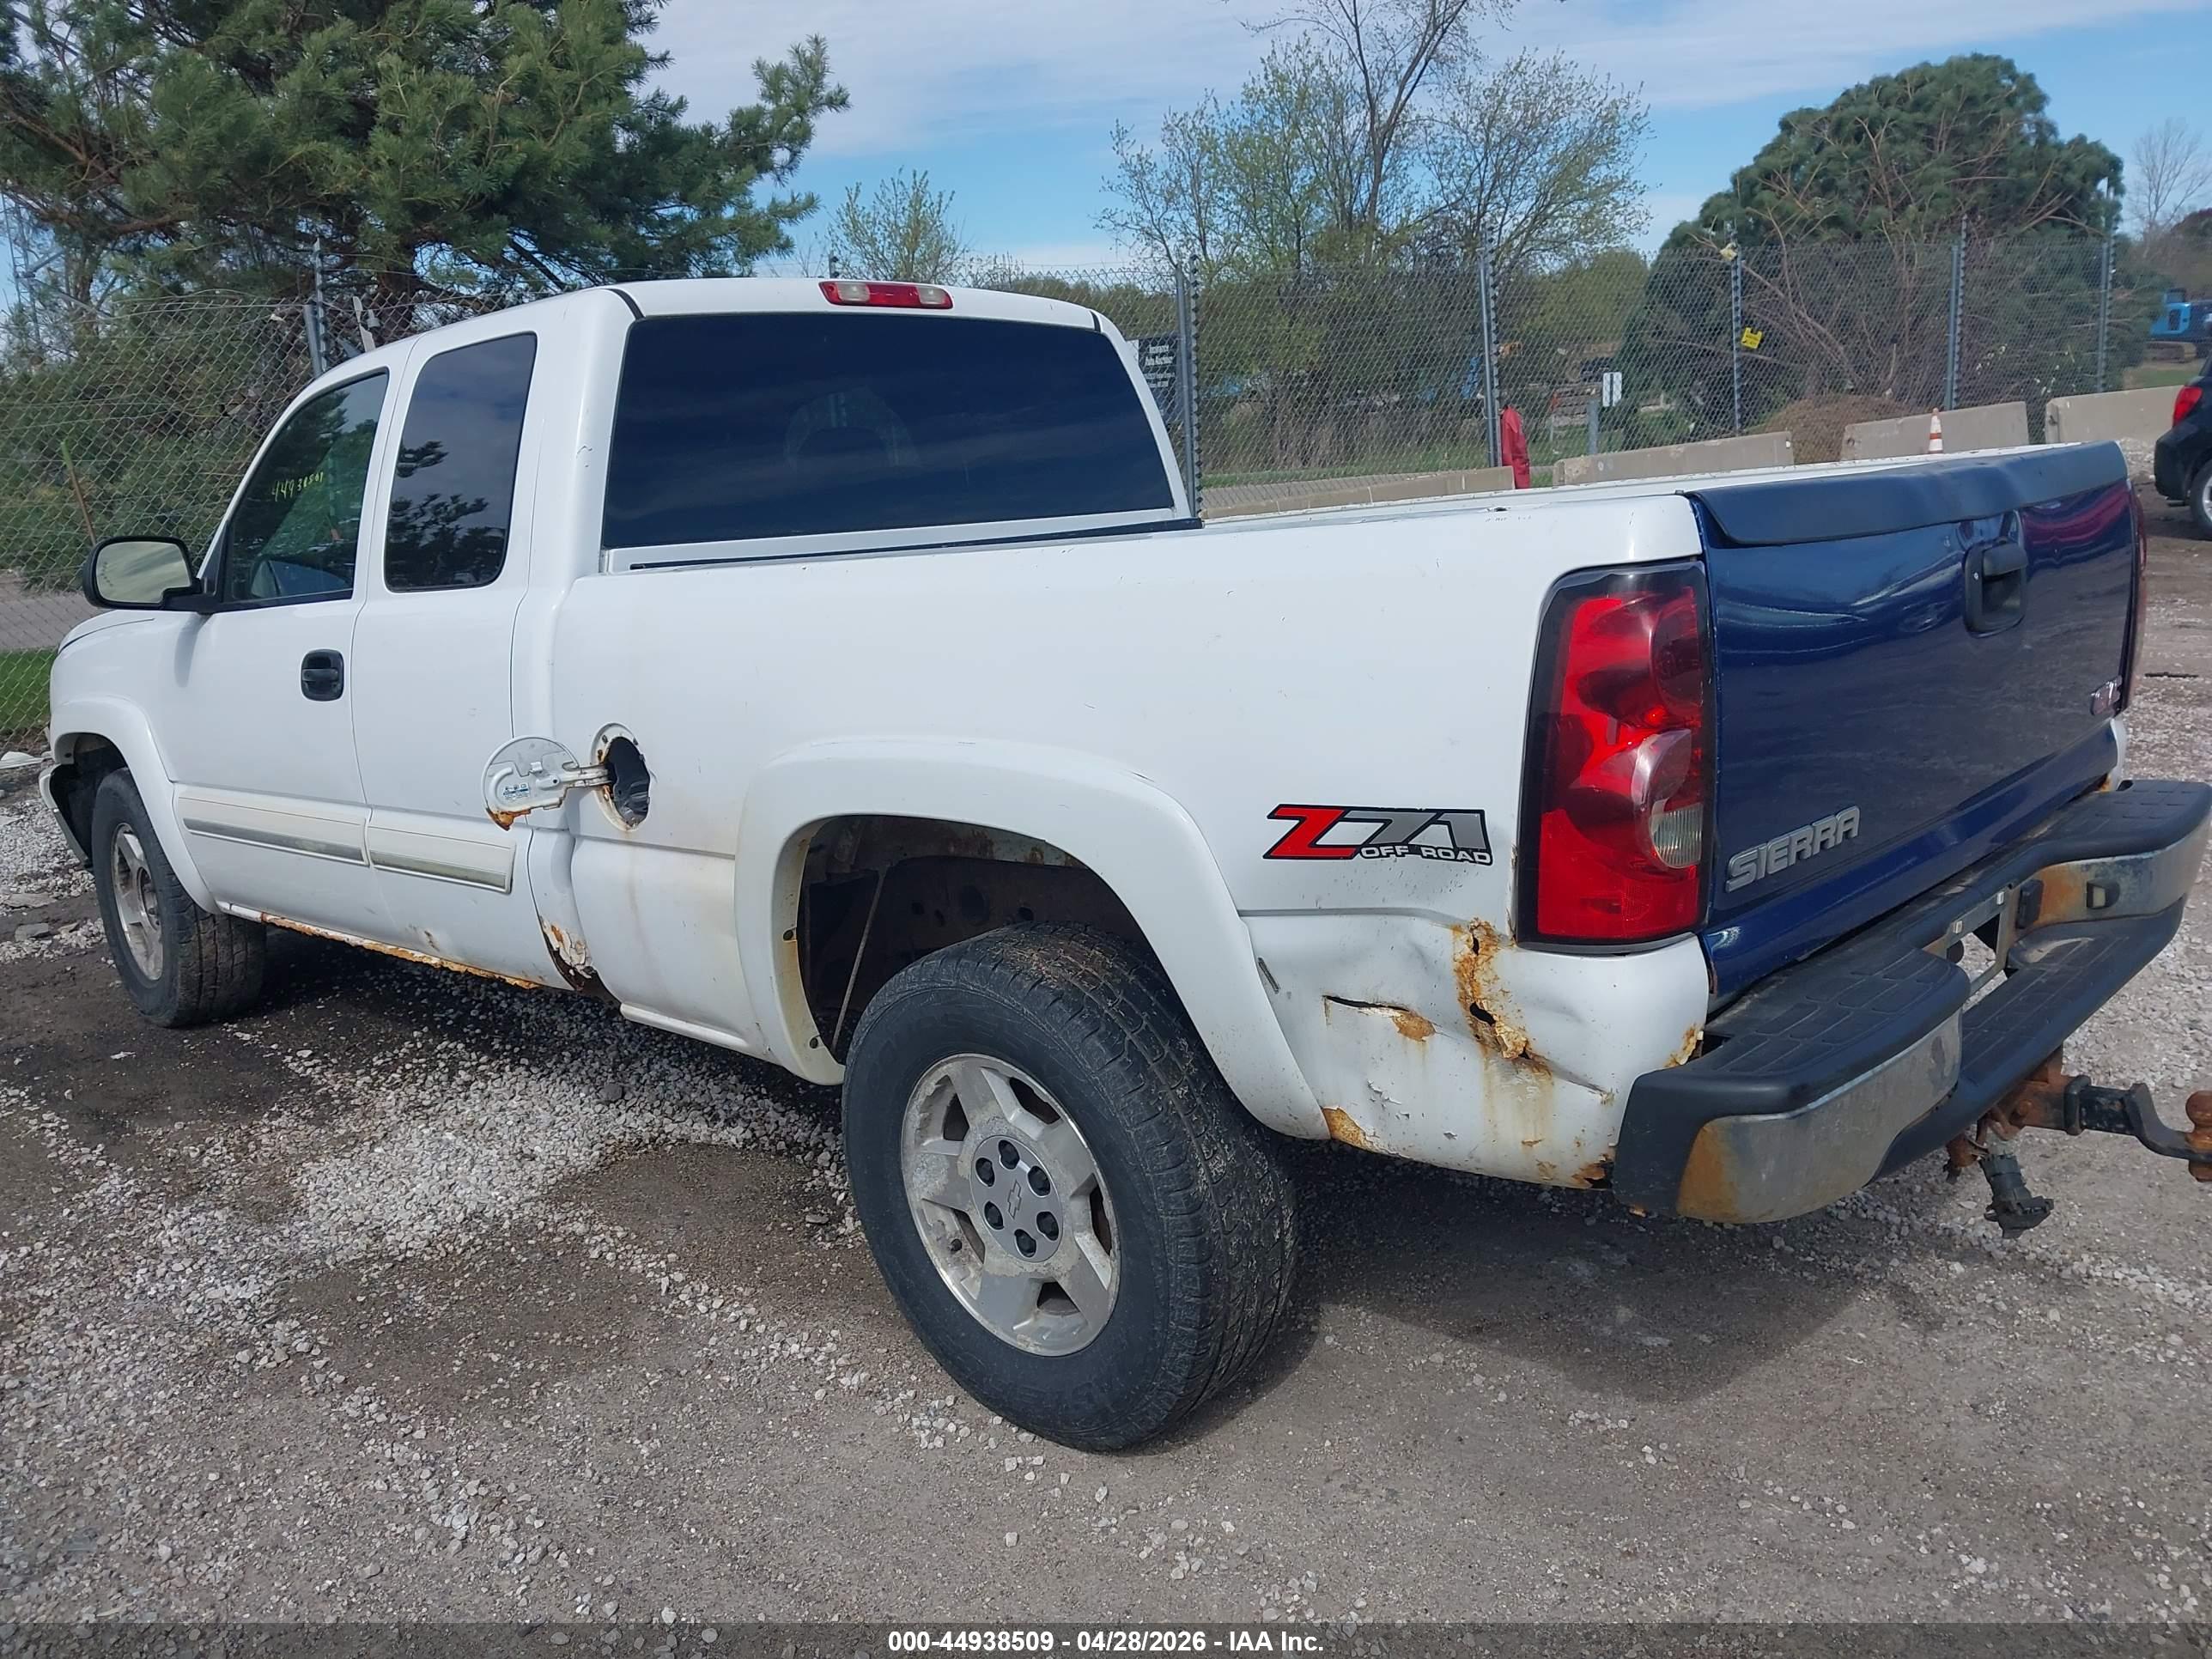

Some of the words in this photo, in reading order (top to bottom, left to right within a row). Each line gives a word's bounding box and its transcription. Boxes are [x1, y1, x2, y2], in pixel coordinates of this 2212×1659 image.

[1262, 804, 1491, 860] Z71
[1359, 845, 1409, 860] OFF
[1420, 846, 1492, 866] ROAD
[1725, 805, 1861, 893] SIERRA
